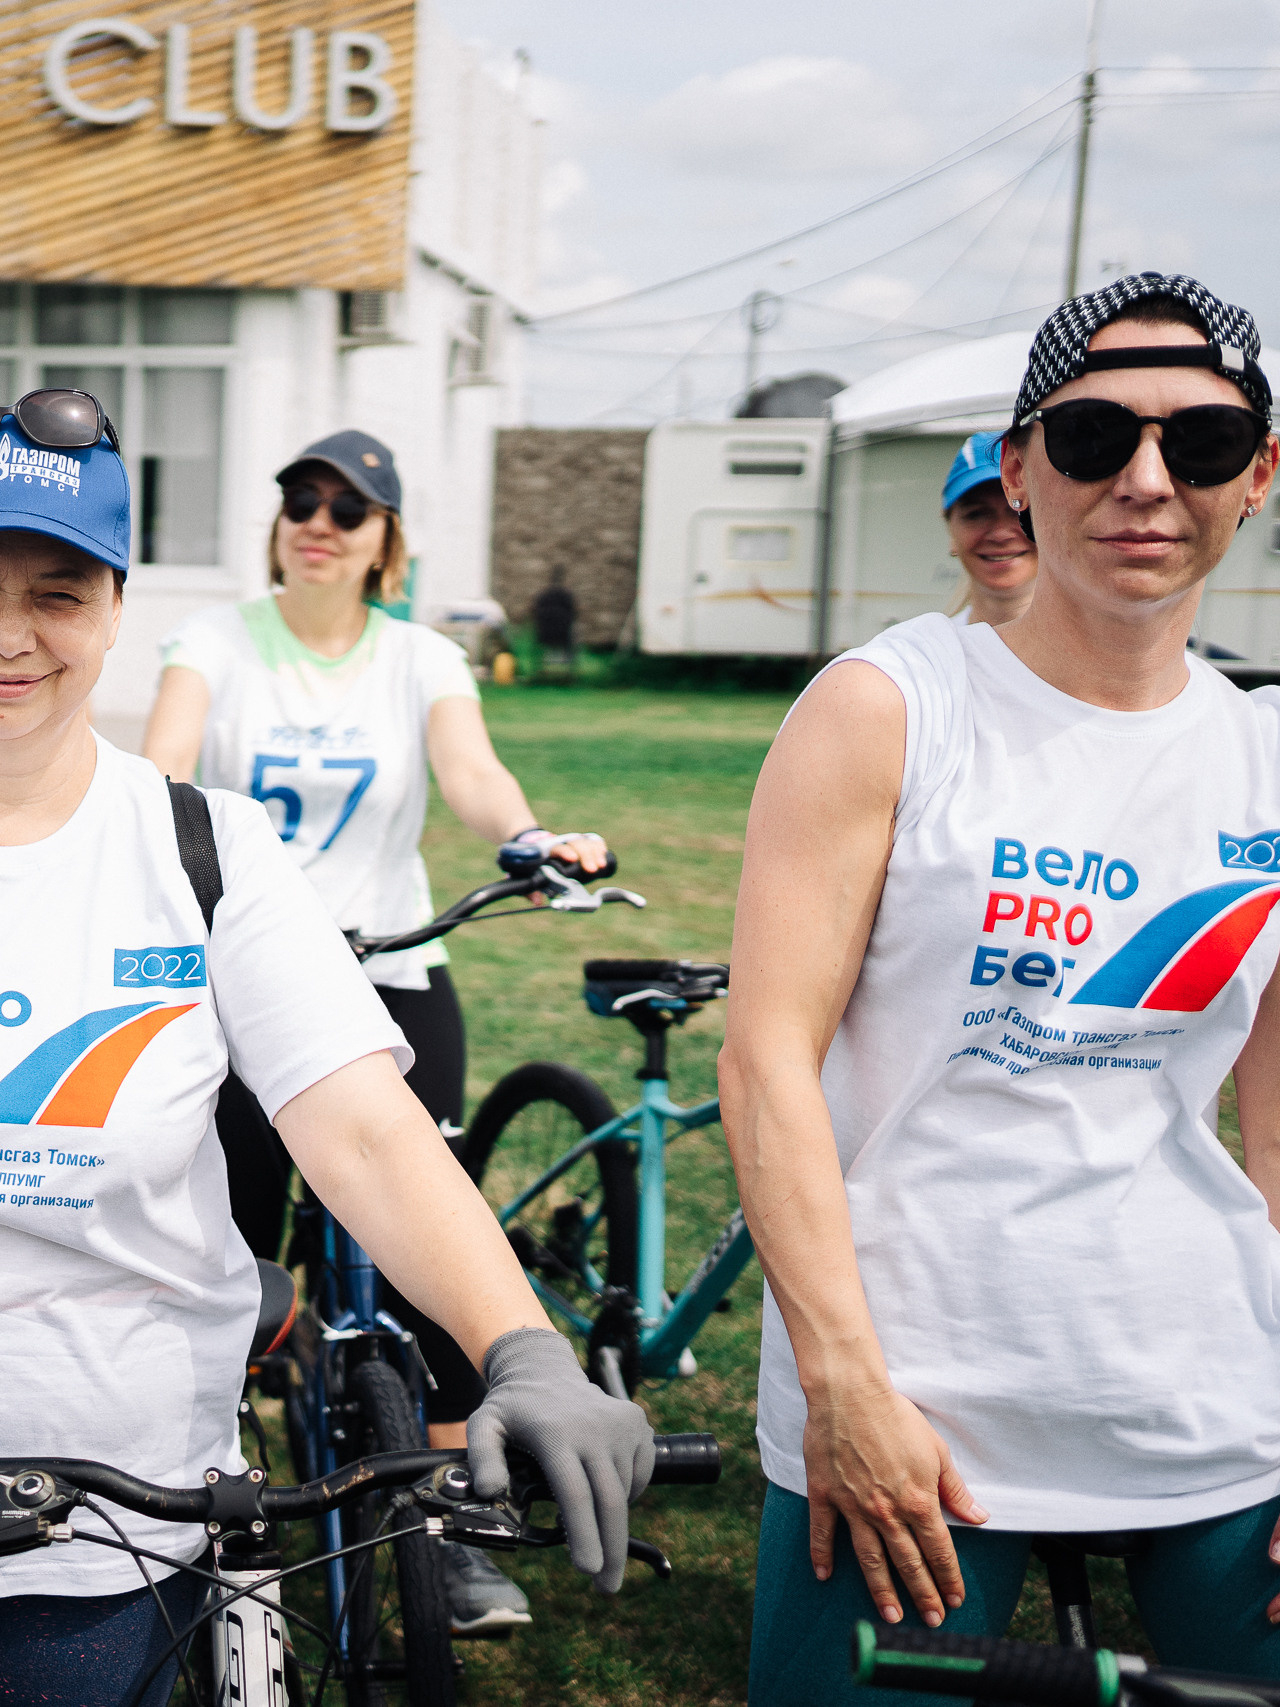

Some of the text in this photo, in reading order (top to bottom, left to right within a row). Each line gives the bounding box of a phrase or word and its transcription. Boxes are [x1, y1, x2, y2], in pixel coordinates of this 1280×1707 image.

[44, 18, 396, 132] CLUB
[12, 447, 81, 478] ГАЗПРОМ
[12, 465, 79, 487] ТРАНСГАЗ
[9, 474, 80, 497] ТОМСК
[251, 754, 377, 851] 57
[982, 890, 1094, 946] PRO
[120, 952, 202, 982] 2022
[962, 1008, 996, 1027] ООО
[997, 1005, 1067, 1042] «Газпром
[1088, 1055, 1162, 1071] организация
[47, 1148, 105, 1168] Томск»
[10, 1193, 95, 1210] организация
